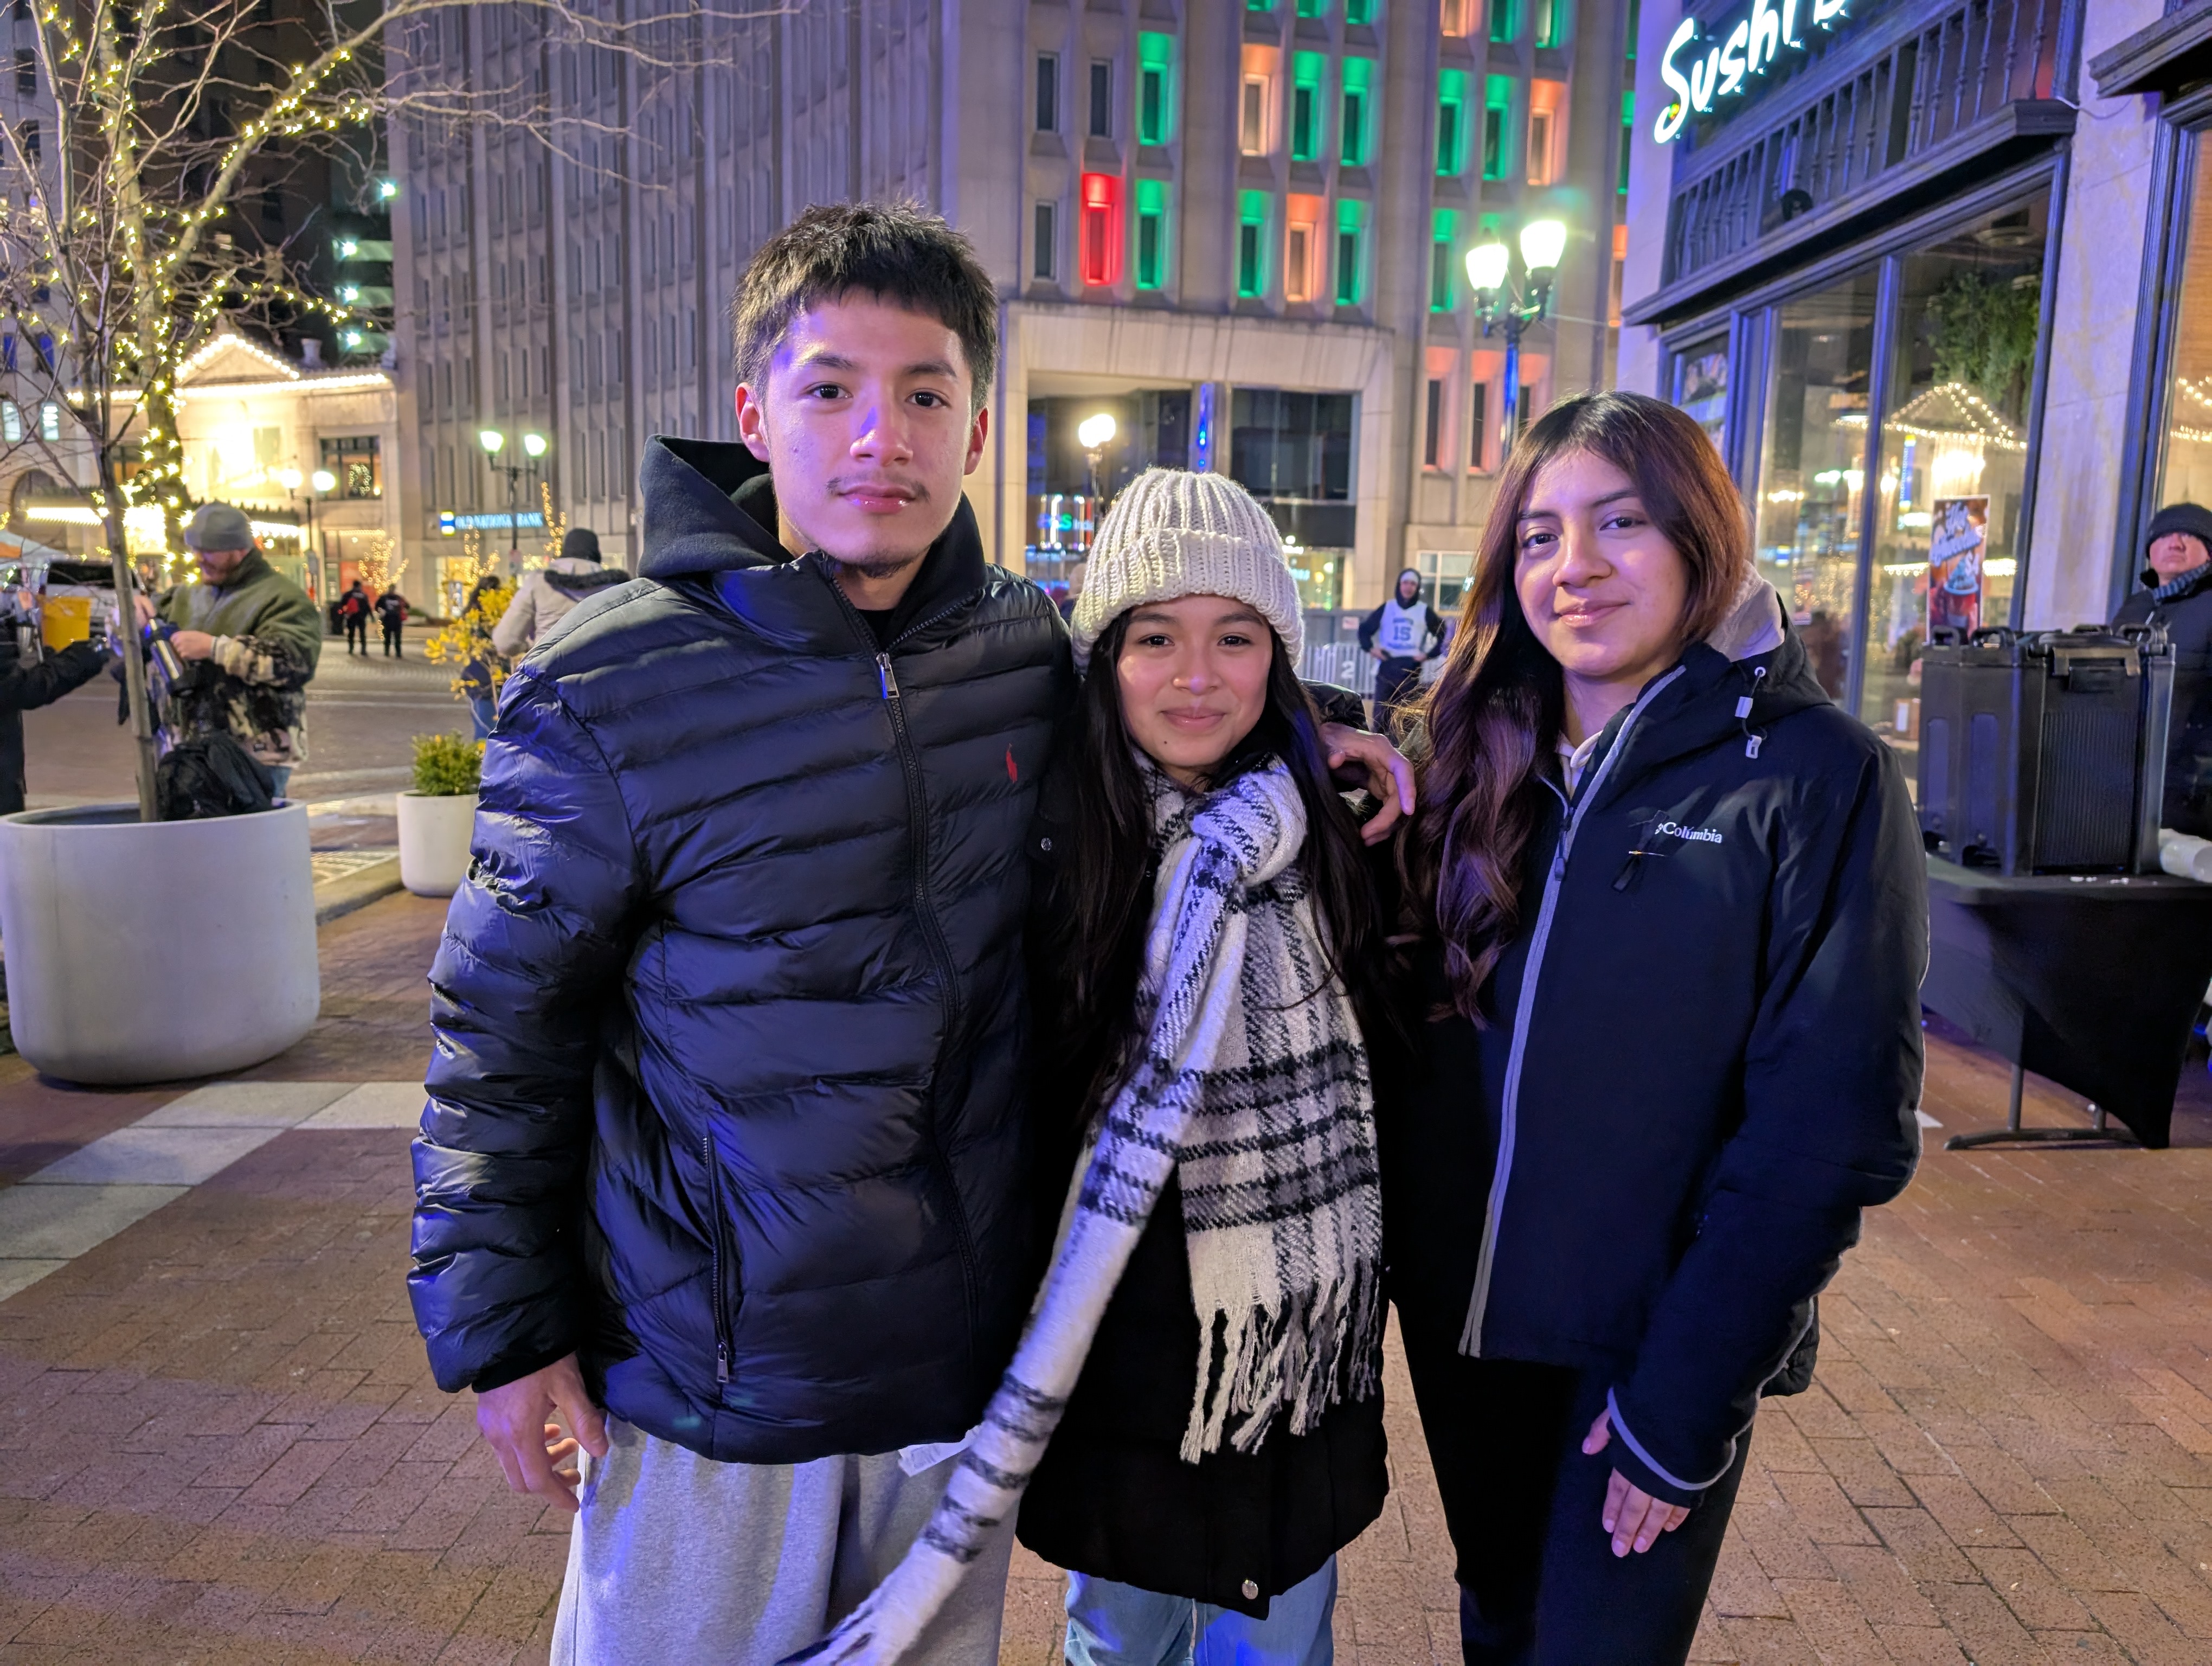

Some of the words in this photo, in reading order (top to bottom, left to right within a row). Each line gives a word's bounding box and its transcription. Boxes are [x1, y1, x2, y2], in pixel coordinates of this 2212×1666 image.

[1654, 0, 1796, 144] Sushi
[474, 514, 513, 529] NATIONA
[1393, 626, 1411, 641] 15
[1663, 822, 1722, 843] Columbia
